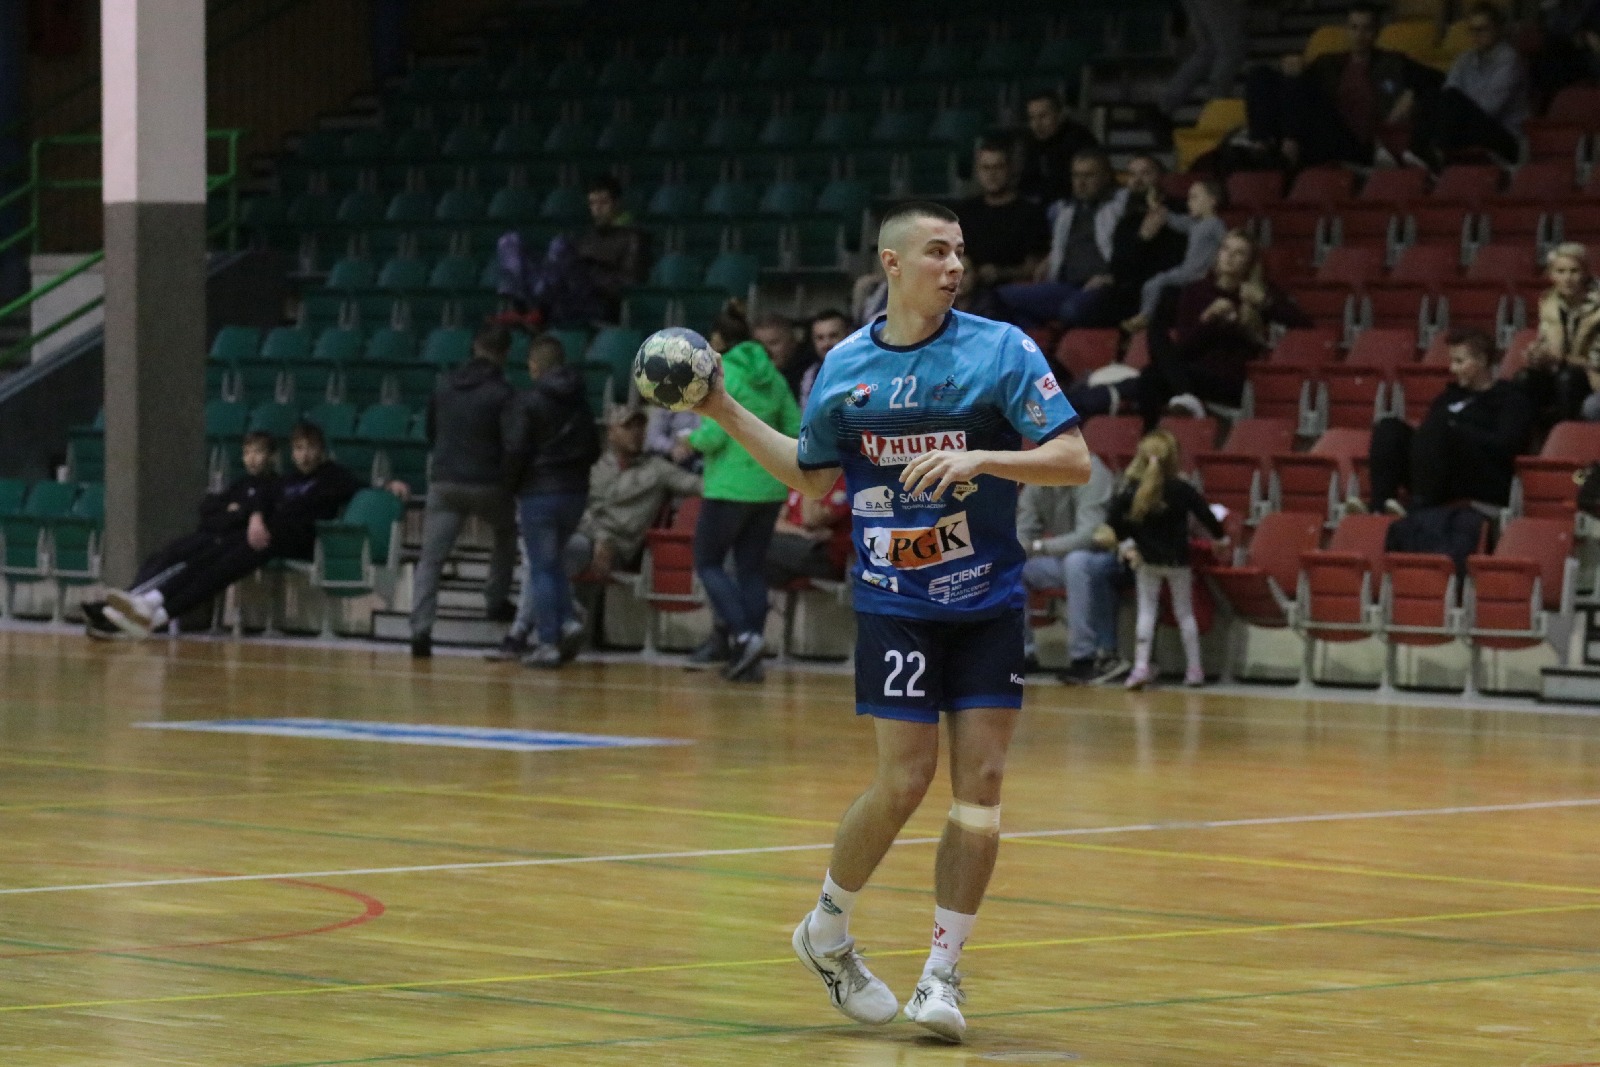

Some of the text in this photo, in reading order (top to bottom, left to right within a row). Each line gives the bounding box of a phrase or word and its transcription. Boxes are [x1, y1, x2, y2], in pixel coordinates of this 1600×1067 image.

[844, 383, 879, 407] BIOPROD
[889, 375, 918, 409] 22
[889, 432, 965, 455] HURAS
[881, 455, 917, 464] STANZA
[865, 501, 893, 509] SAG
[883, 649, 926, 697] 22
